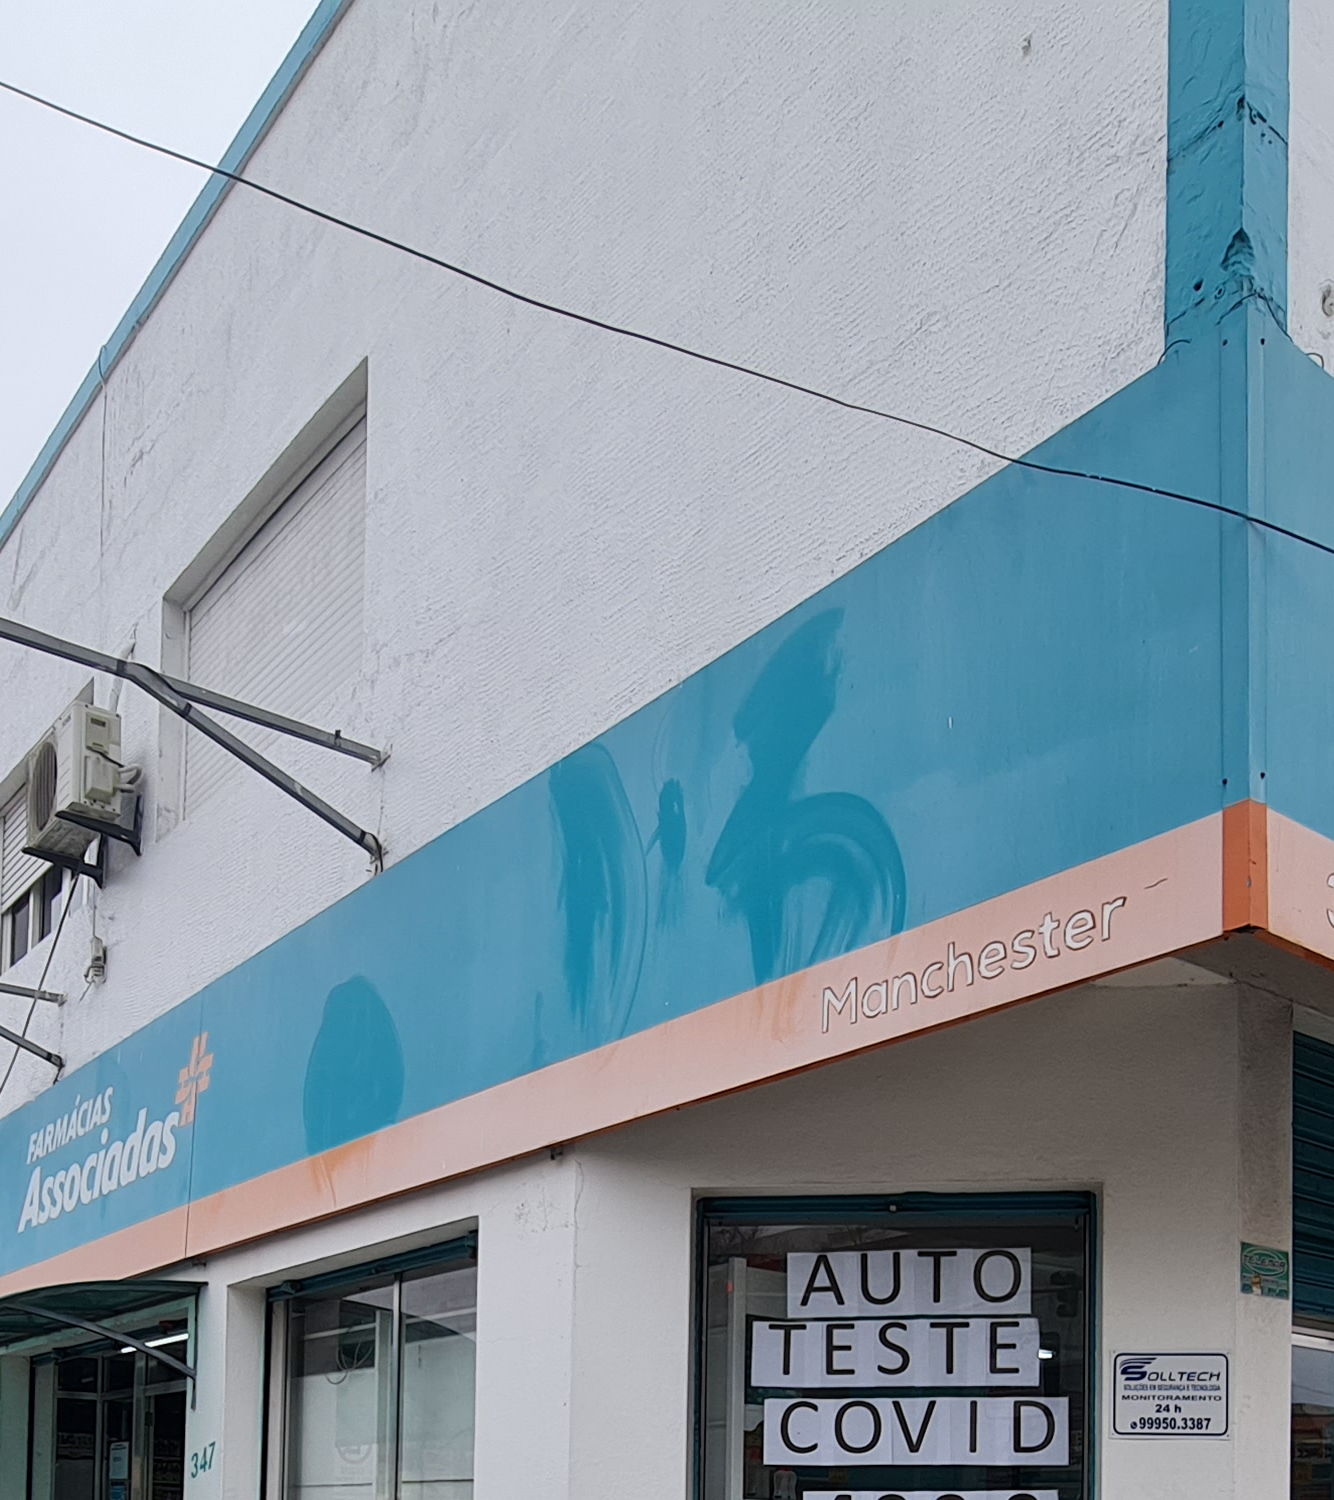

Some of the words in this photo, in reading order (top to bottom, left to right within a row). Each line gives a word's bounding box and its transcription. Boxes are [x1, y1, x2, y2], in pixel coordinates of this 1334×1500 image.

[821, 895, 1128, 1034] Manchester
[26, 1086, 115, 1165] FARMÁCIAS
[17, 1106, 181, 1234] Associadas
[799, 1248, 1023, 1307] AUTO
[767, 1320, 1021, 1376] TESTE
[1120, 1364, 1221, 1382] SOLLTECH
[1121, 1394, 1223, 1402] MONITORAMENTO
[1139, 1416, 1212, 1430] 99950.3387
[1155, 1404, 1171, 1413] 24
[1174, 1404, 1182, 1413] h
[779, 1400, 1056, 1455] COVID
[190, 1441, 216, 1479] 347
